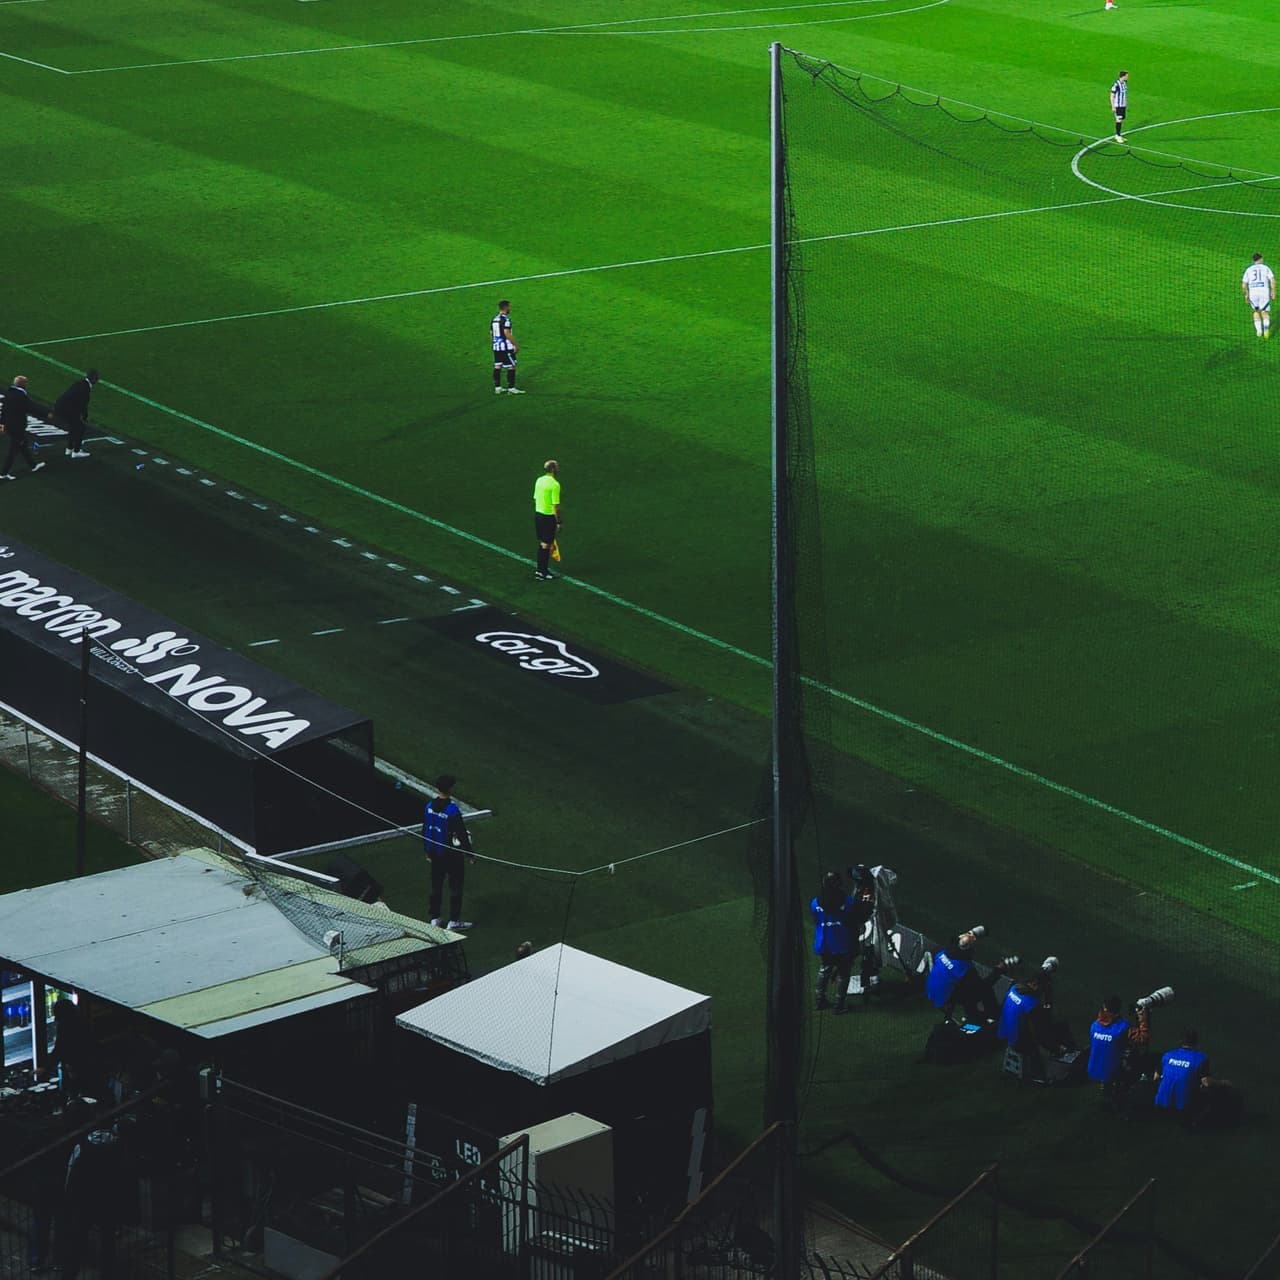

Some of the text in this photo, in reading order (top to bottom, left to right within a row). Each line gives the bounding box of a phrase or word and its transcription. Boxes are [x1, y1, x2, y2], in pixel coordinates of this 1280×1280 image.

[1252, 269, 1263, 281] 31
[0, 570, 122, 644] macron
[475, 631, 600, 679] car.gr
[143, 663, 311, 750] NOVA
[1168, 1057, 1191, 1069] PHOTO
[456, 1138, 481, 1166] LED
